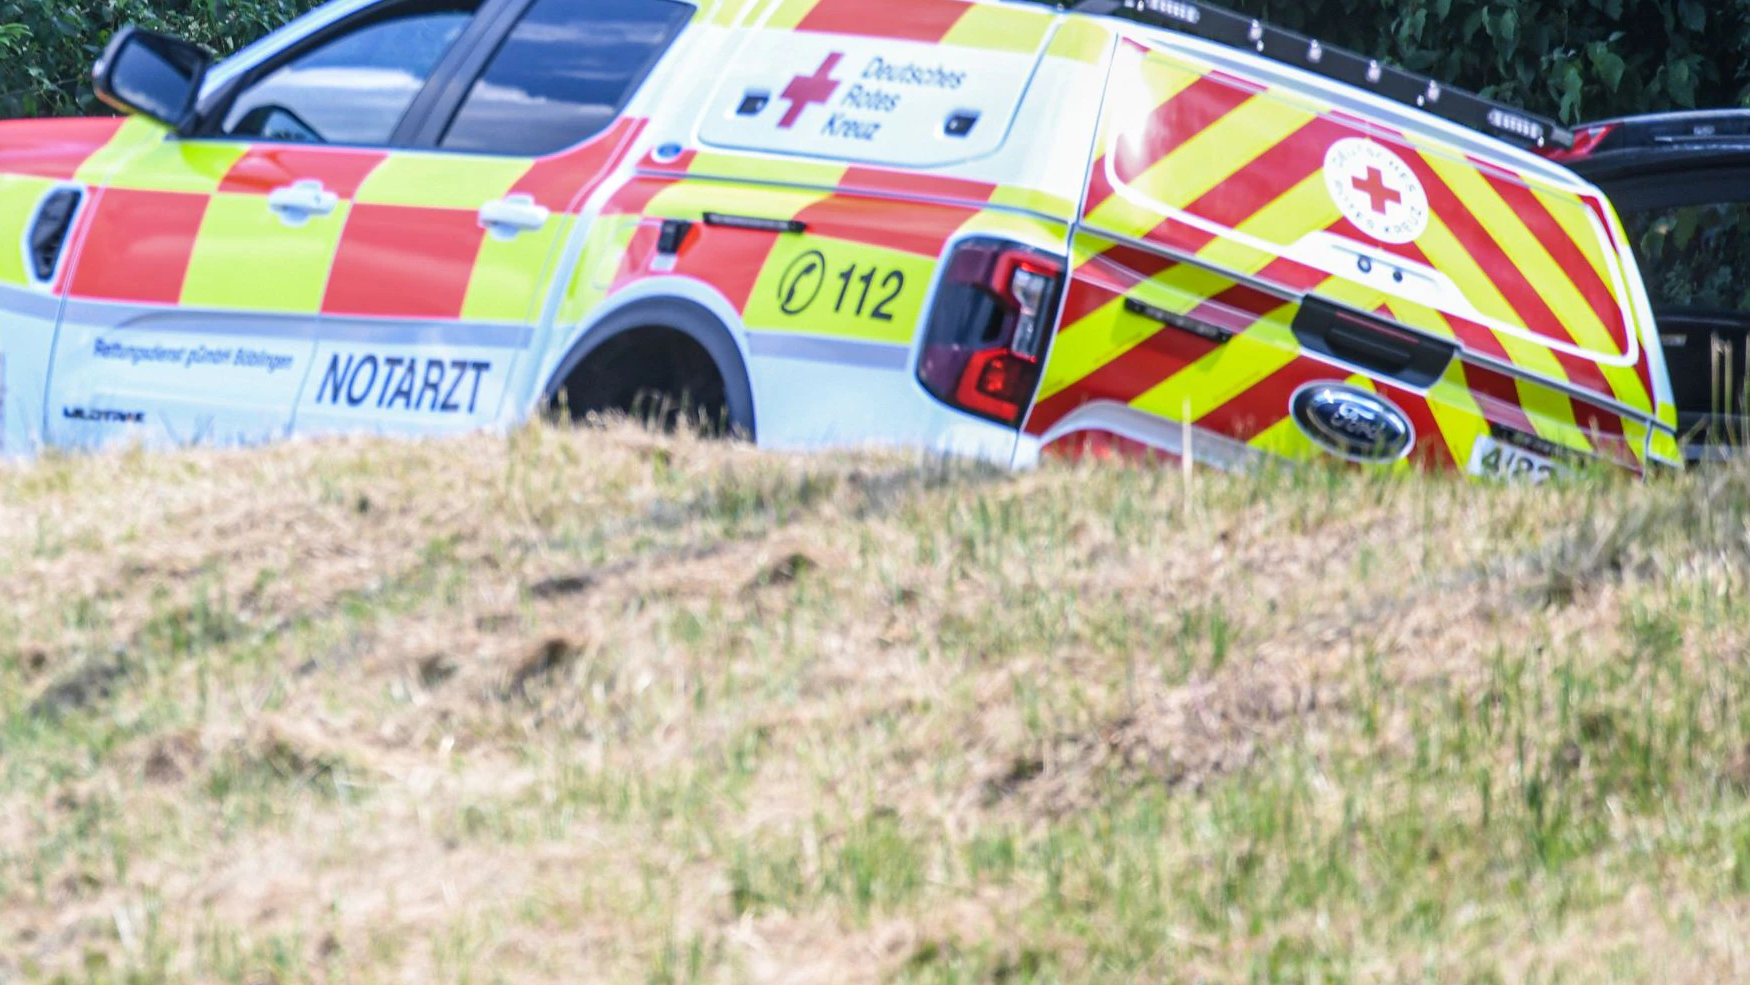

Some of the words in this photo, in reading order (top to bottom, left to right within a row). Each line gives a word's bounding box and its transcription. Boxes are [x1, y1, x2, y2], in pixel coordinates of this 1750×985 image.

[861, 56, 966, 89] Deutsches
[841, 83, 900, 112] Rotes
[821, 112, 880, 141] Kreuz
[835, 263, 904, 322] 112
[315, 352, 491, 414] NOTARZT
[1330, 400, 1388, 441] Ford
